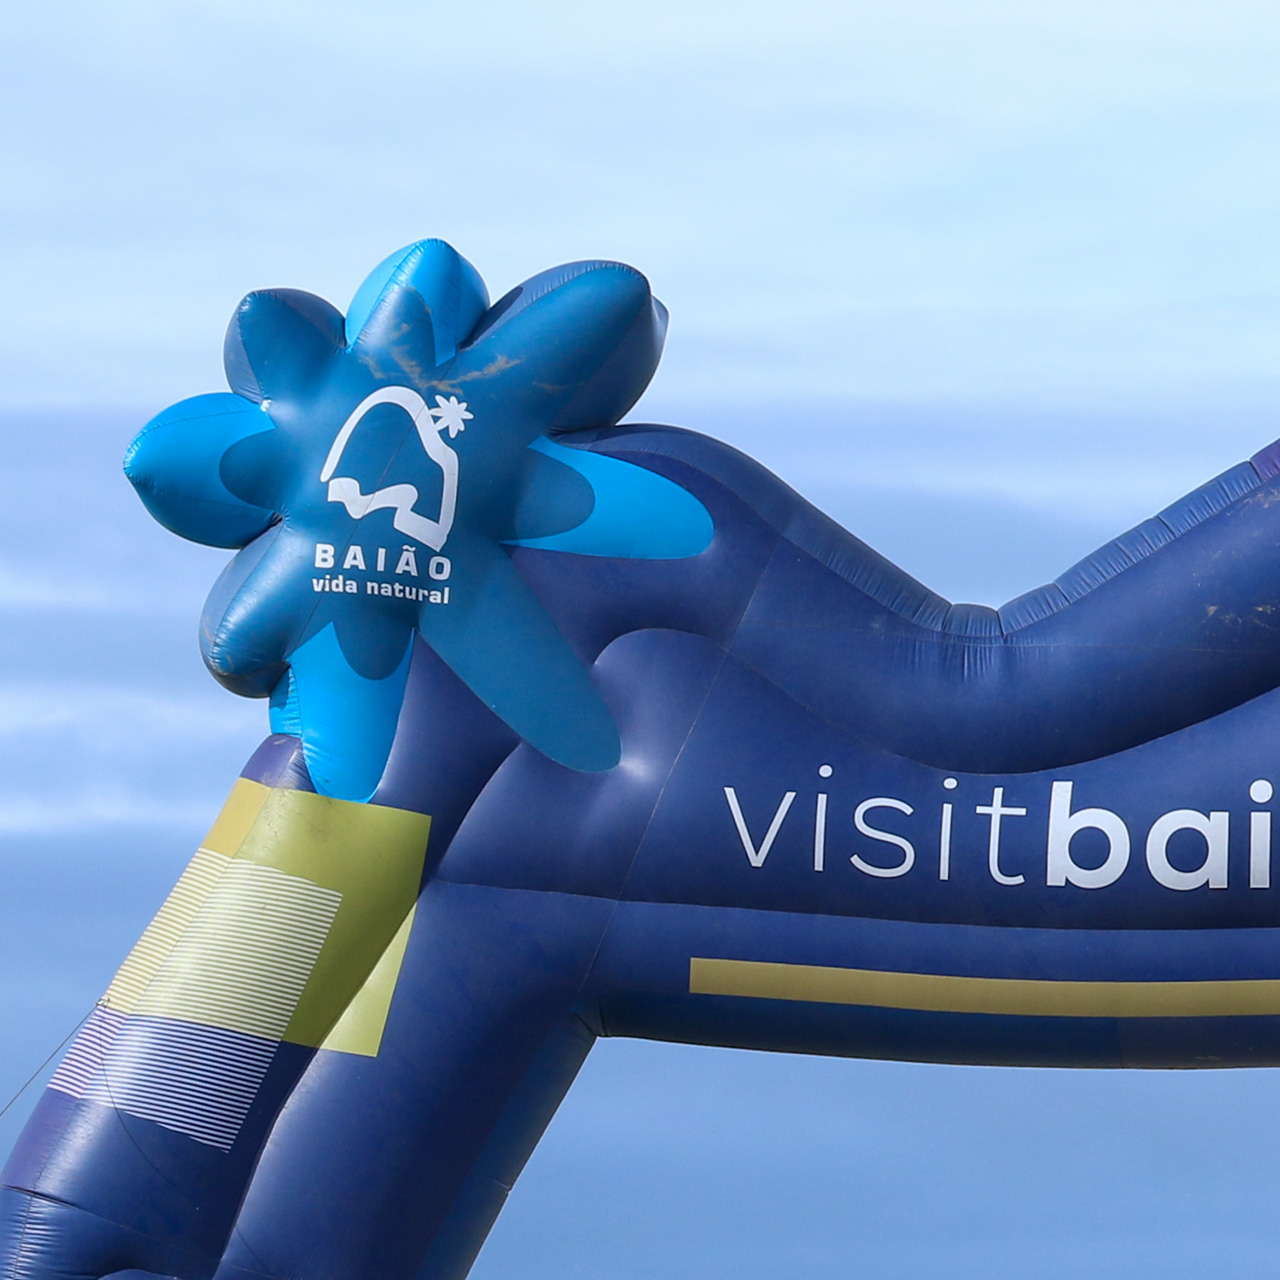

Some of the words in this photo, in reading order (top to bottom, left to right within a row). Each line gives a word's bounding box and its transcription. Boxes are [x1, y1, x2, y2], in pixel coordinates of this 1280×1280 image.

[314, 543, 452, 581] BAIÃO
[312, 575, 358, 594] vida
[366, 580, 451, 604] natural
